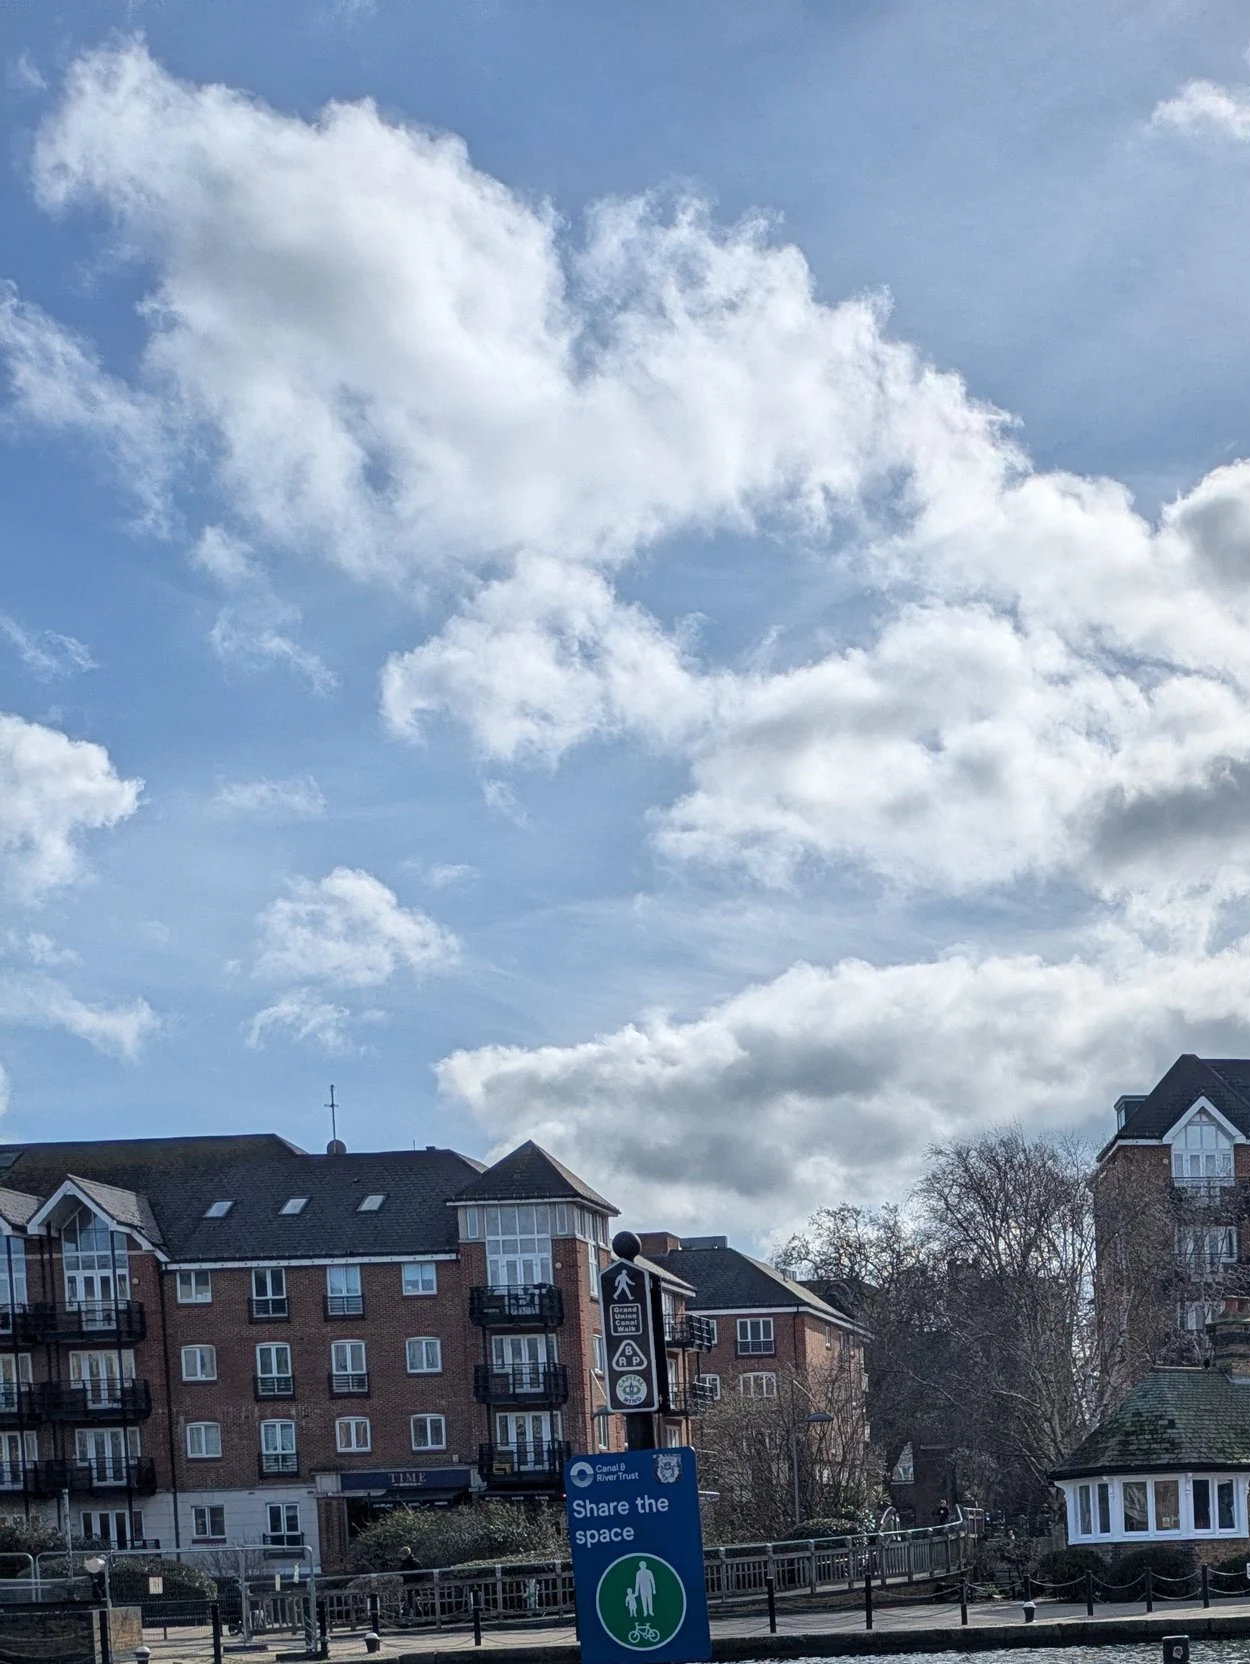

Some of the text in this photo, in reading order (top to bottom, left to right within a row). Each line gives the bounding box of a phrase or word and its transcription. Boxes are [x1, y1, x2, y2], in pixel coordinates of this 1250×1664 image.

[625, 1345, 633, 1356] B
[619, 1356, 640, 1367] R P
[618, 1375, 645, 1388] CAPITAL
[595, 1464, 619, 1473] Canal
[388, 1472, 427, 1483] TIME
[596, 1472, 639, 1482] River Trust
[572, 1494, 669, 1519] Share the
[575, 1526, 635, 1549] space
